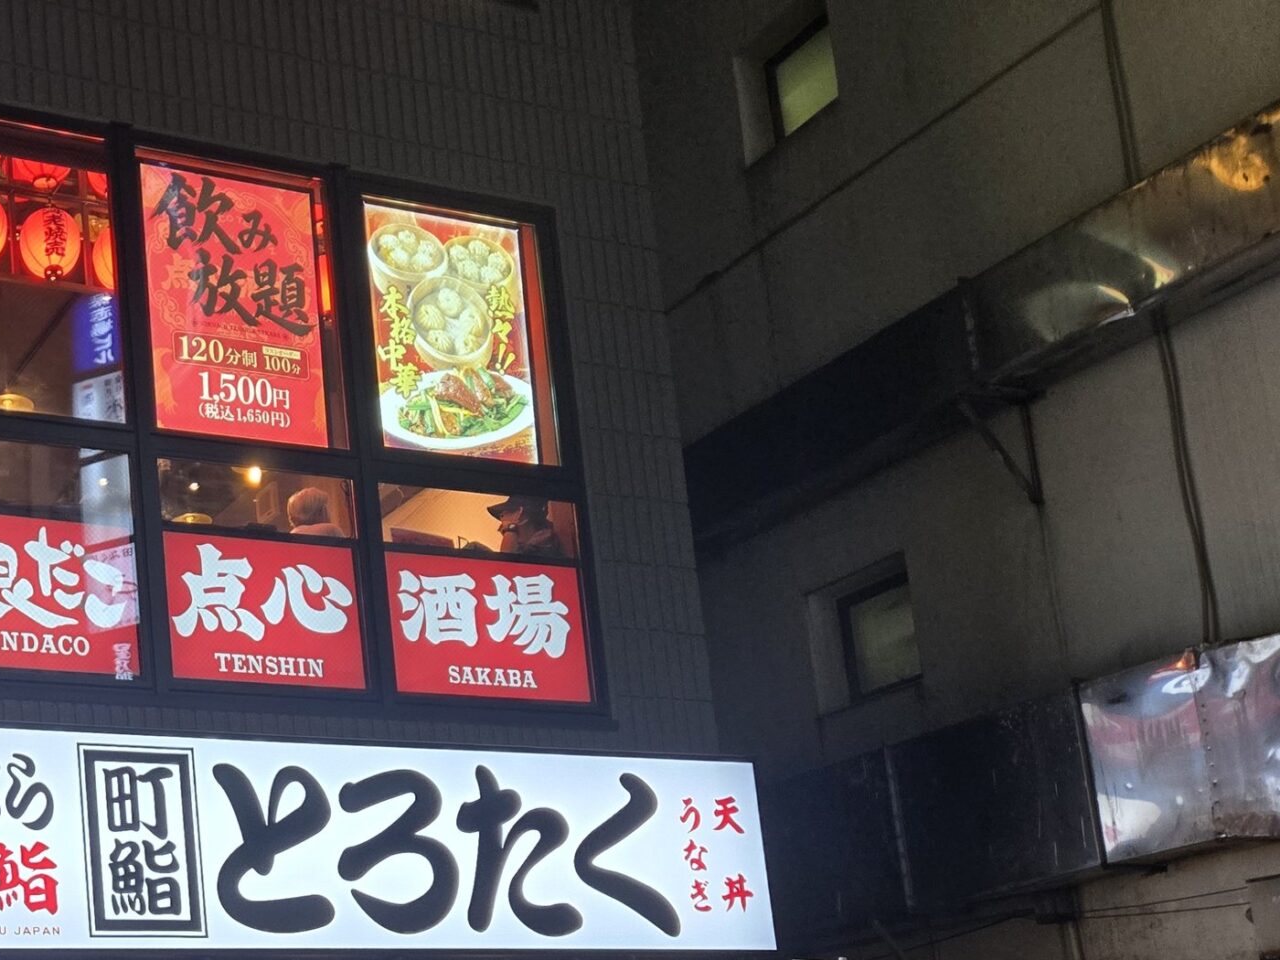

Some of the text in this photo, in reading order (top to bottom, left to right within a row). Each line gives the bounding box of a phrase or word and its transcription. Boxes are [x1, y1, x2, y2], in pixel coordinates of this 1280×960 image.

[149, 172, 278, 254] 飲み
[188, 248, 318, 337] 放題
[178, 335, 258, 368] 120分制
[264, 355, 301, 375] 100分
[377, 285, 423, 398] 本格中華
[198, 371, 290, 410] 1,500円
[171, 542, 353, 641] 点心
[398, 569, 571, 658] 酒場
[214, 652, 324, 680] TENSHIN
[448, 665, 538, 690] SAKABA
[102, 765, 182, 917] 町鮨
[212, 763, 681, 938] とろたく
[679, 797, 713, 913] うなぎ
[712, 796, 753, 914] 天丼
[14, 926, 60, 936] JAPAN
